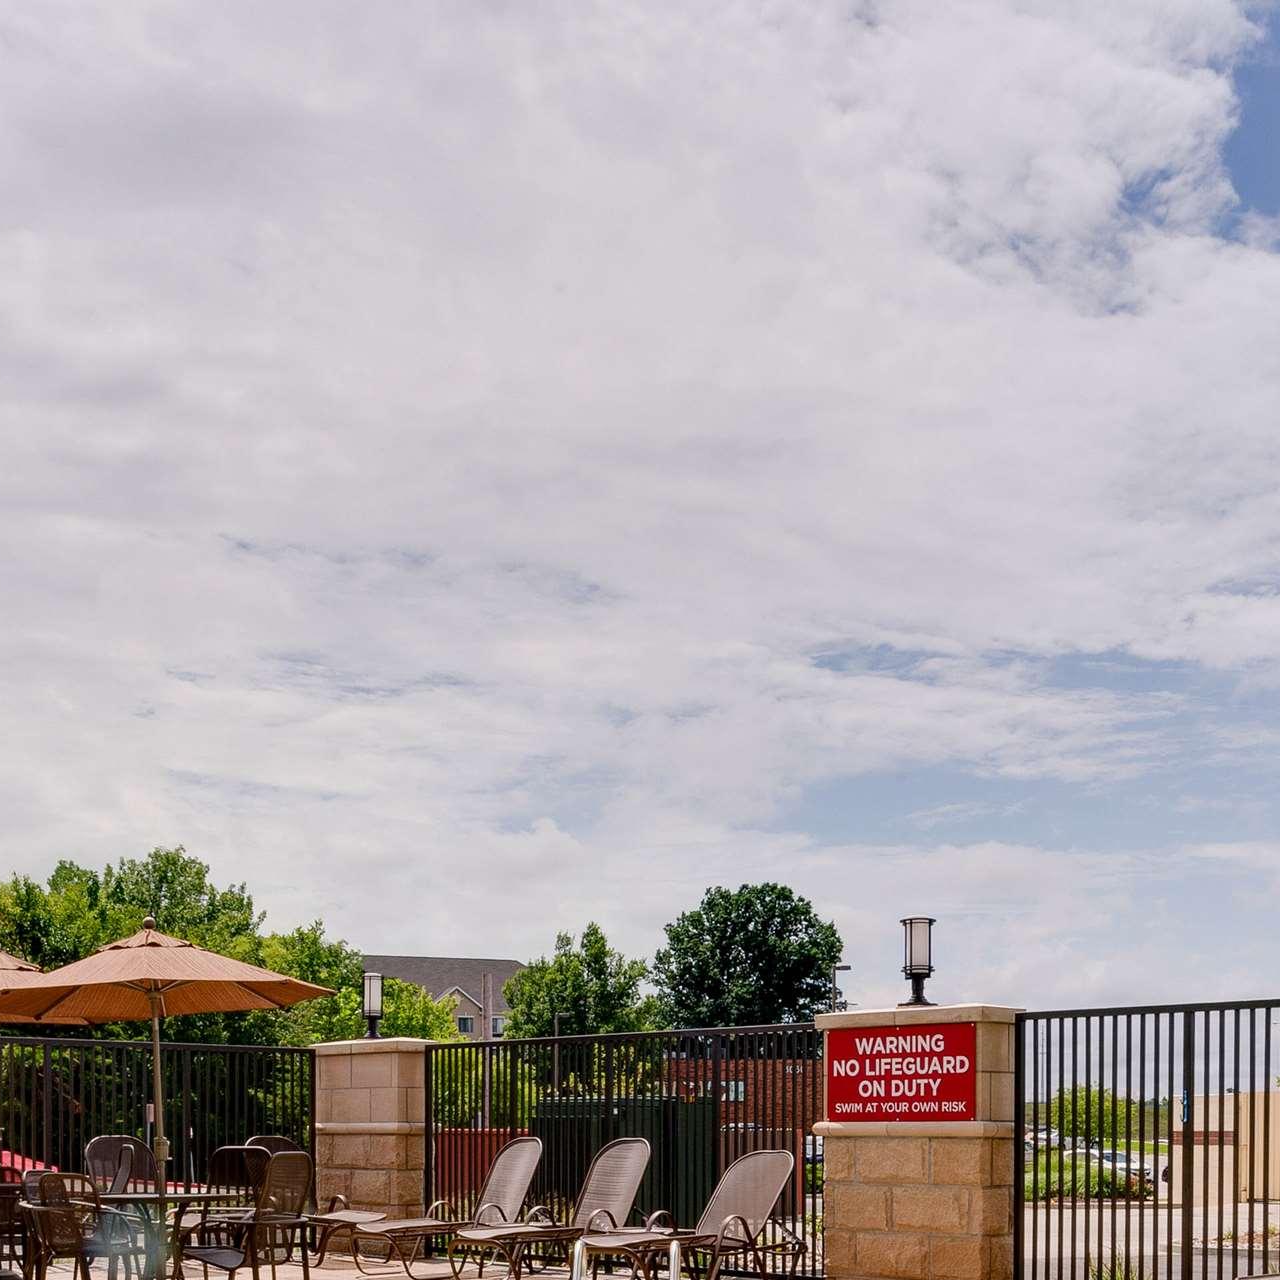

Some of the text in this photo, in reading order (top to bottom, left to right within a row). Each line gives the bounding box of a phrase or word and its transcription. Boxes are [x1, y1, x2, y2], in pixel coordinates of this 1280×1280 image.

[855, 1033, 945, 1055] WARNING
[833, 1055, 970, 1077] NO LIFEGUARD
[858, 1078, 942, 1098] ON DUTY
[835, 1101, 967, 1114] SWIM AT YOUR OWN RISK
